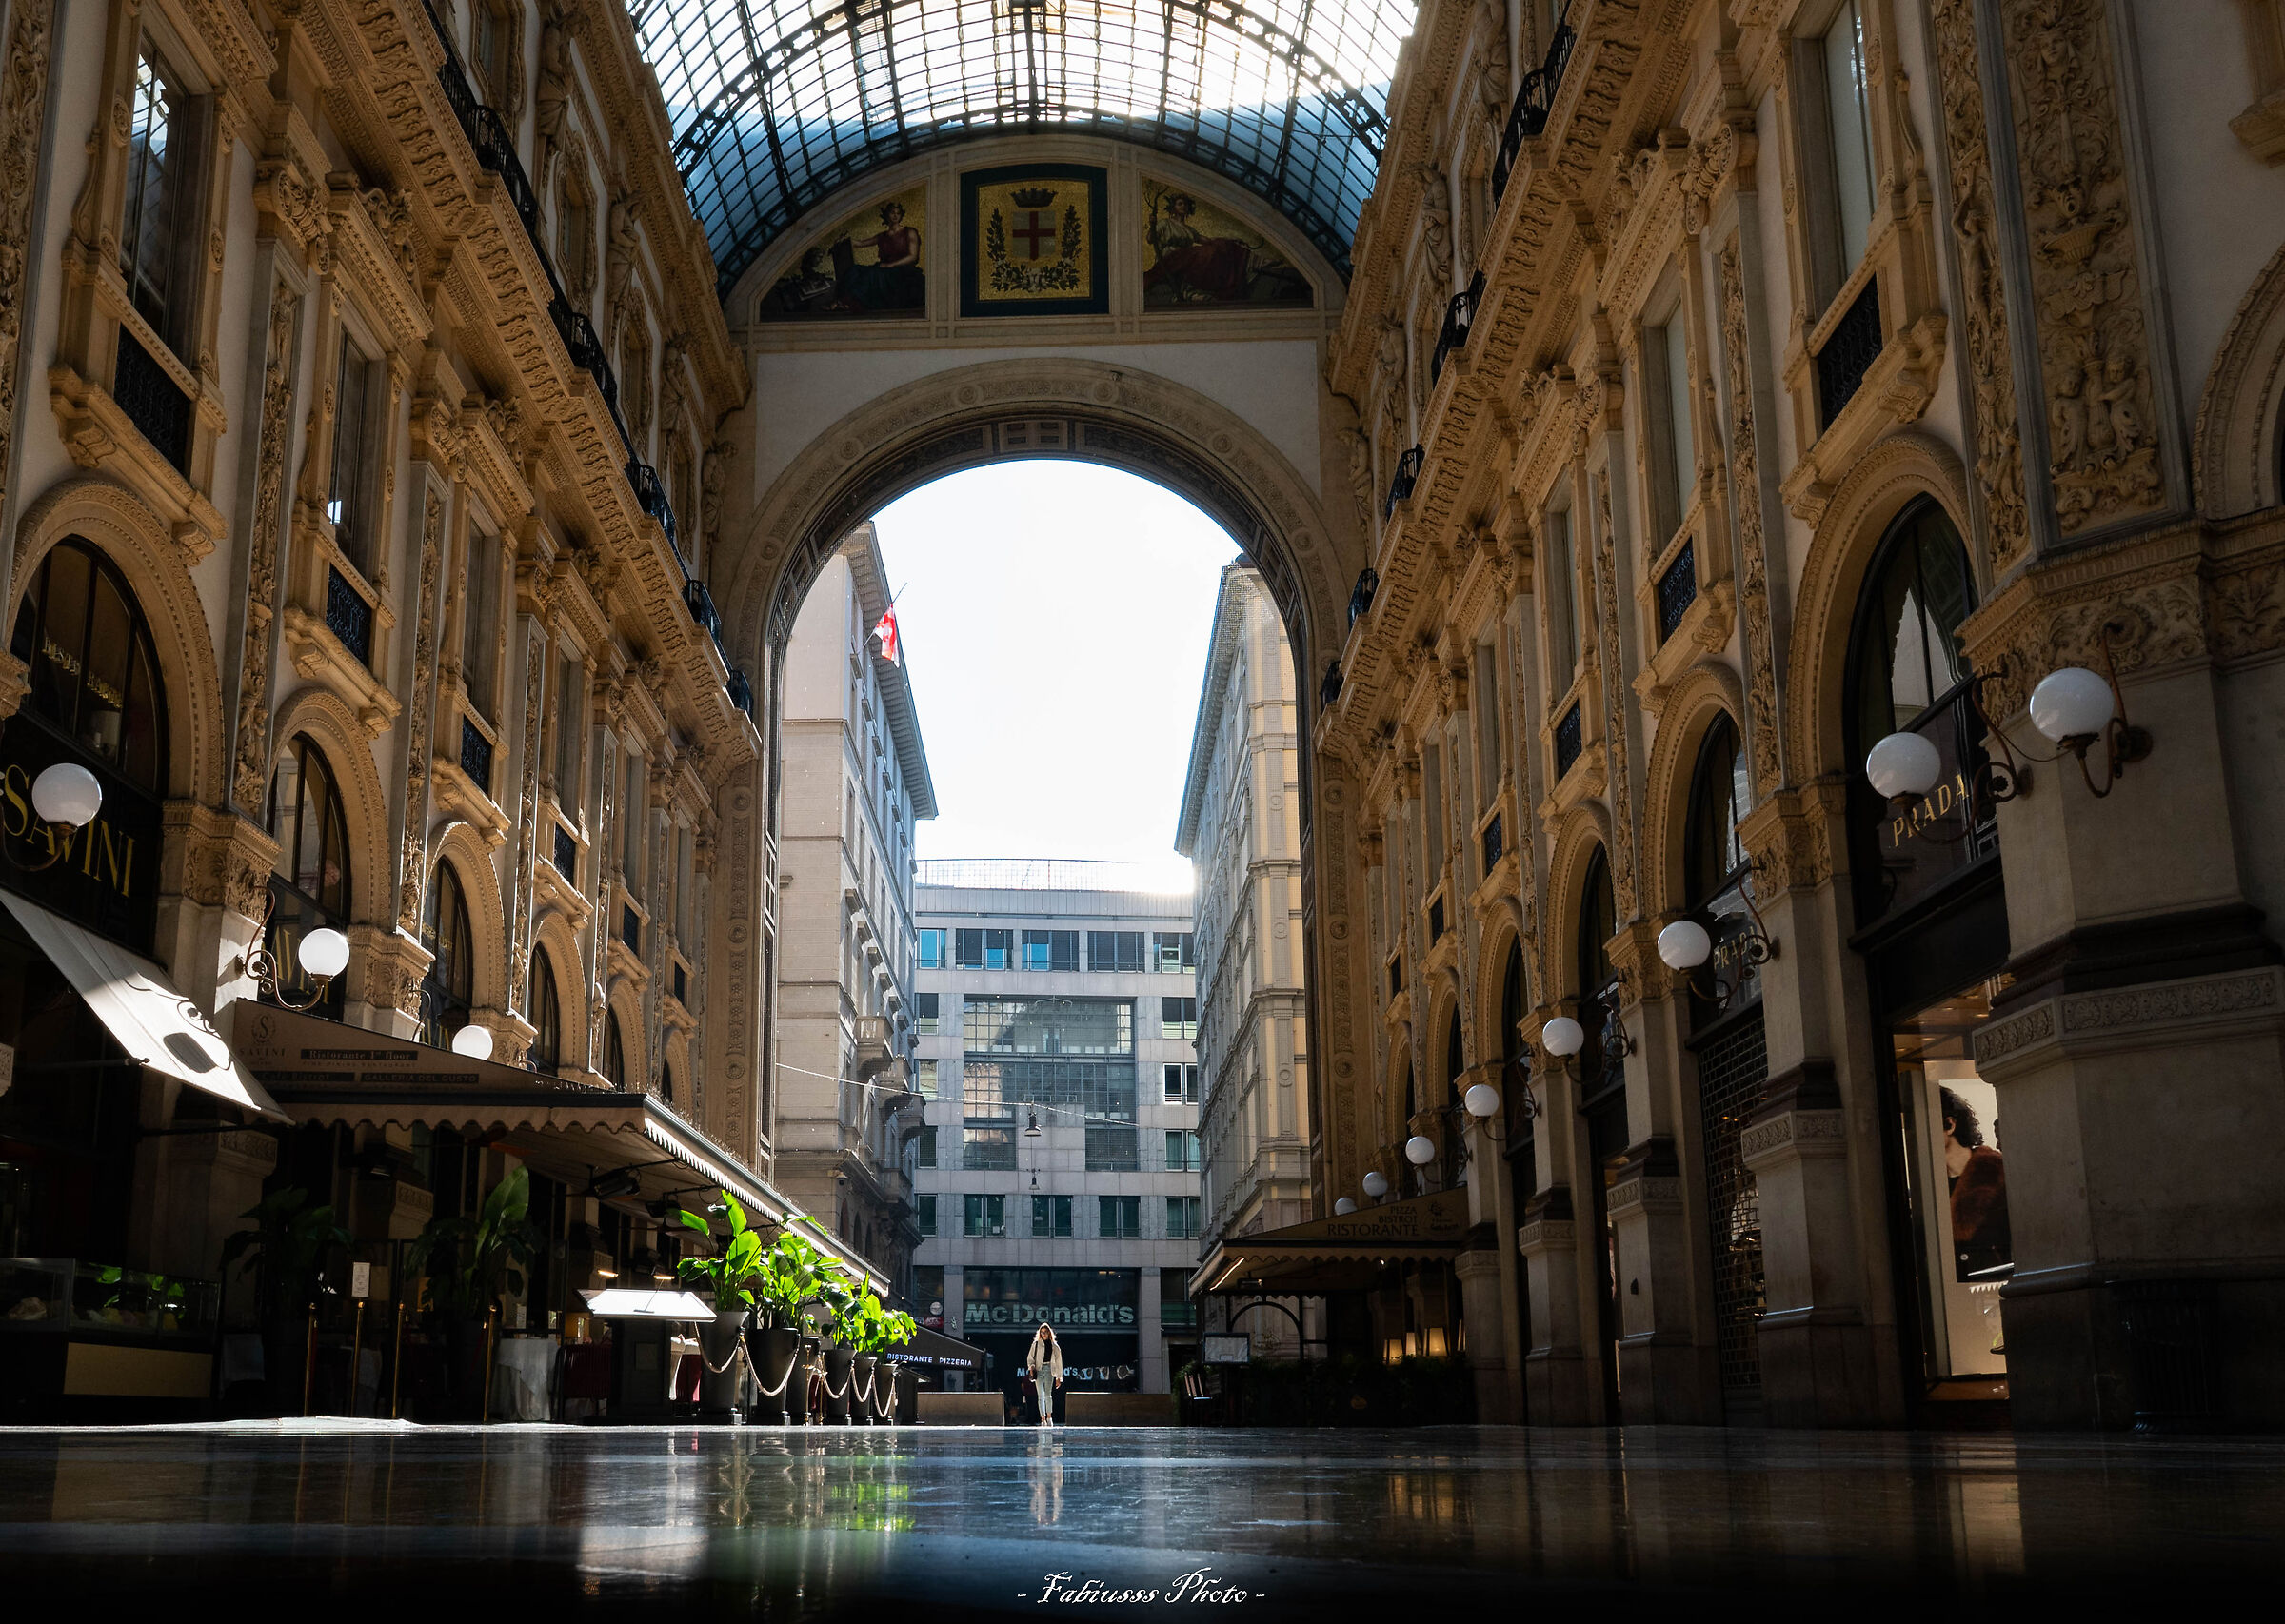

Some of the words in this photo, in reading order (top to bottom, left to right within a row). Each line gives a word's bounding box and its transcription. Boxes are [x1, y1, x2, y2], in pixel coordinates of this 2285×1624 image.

[1892, 773, 1970, 847] PRADA
[239, 1048, 286, 1057] SAVINI
[308, 1050, 366, 1060] Ristorante
[385, 1050, 412, 1060] floor
[365, 1073, 414, 1082] GALLERIA
[418, 1074, 437, 1082] DEL
[441, 1074, 477, 1082] GUSTO
[1390, 1205, 1418, 1215] PIZZA
[1378, 1215, 1418, 1224] BISTROT
[1327, 1224, 1420, 1237] RISTORANTE
[965, 1303, 1135, 1325] McDonald's
[886, 1352, 933, 1363] RISTORANTE
[939, 1357, 973, 1366] PIZZERIA
